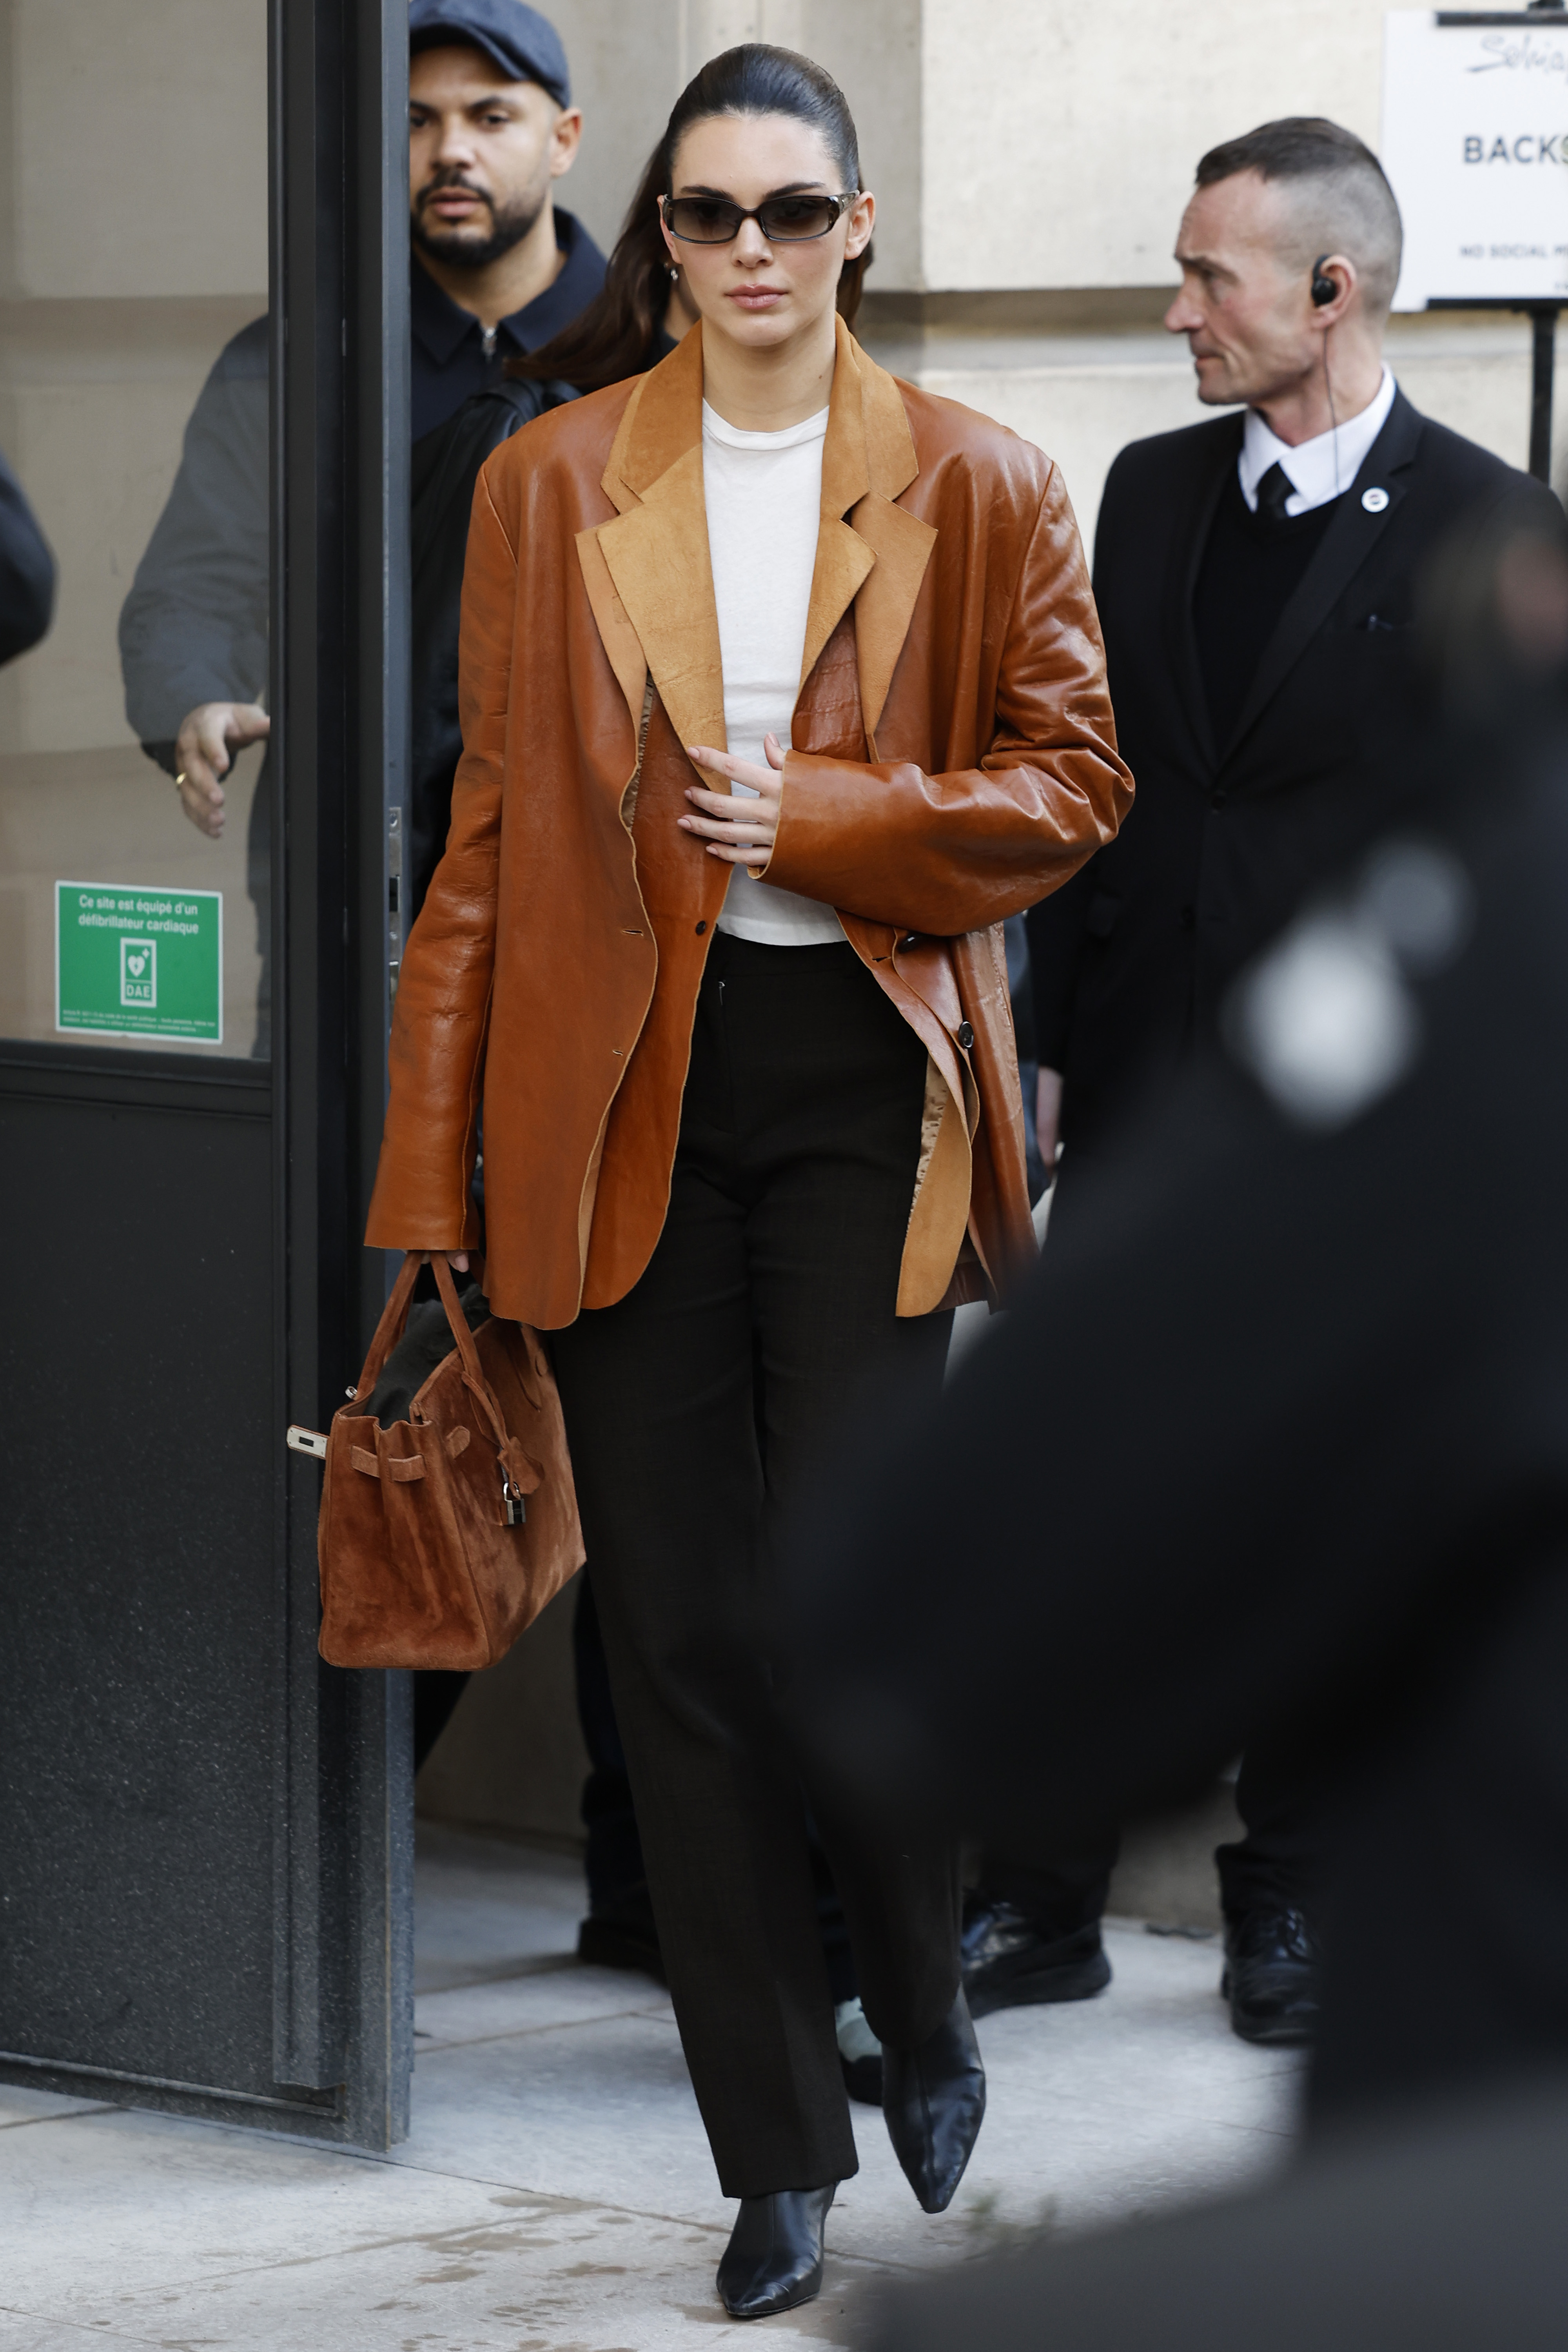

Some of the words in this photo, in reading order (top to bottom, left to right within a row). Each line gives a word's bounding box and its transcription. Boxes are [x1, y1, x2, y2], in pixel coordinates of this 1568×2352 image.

[79, 895, 94, 908] Ce
[97, 896, 115, 909] site
[118, 899, 134, 911] est
[136, 898, 172, 916] équipé
[175, 902, 198, 915] d'un
[79, 913, 144, 929] défibrillateur
[147, 920, 199, 935] cardiaque
[126, 984, 151, 998] DAE
